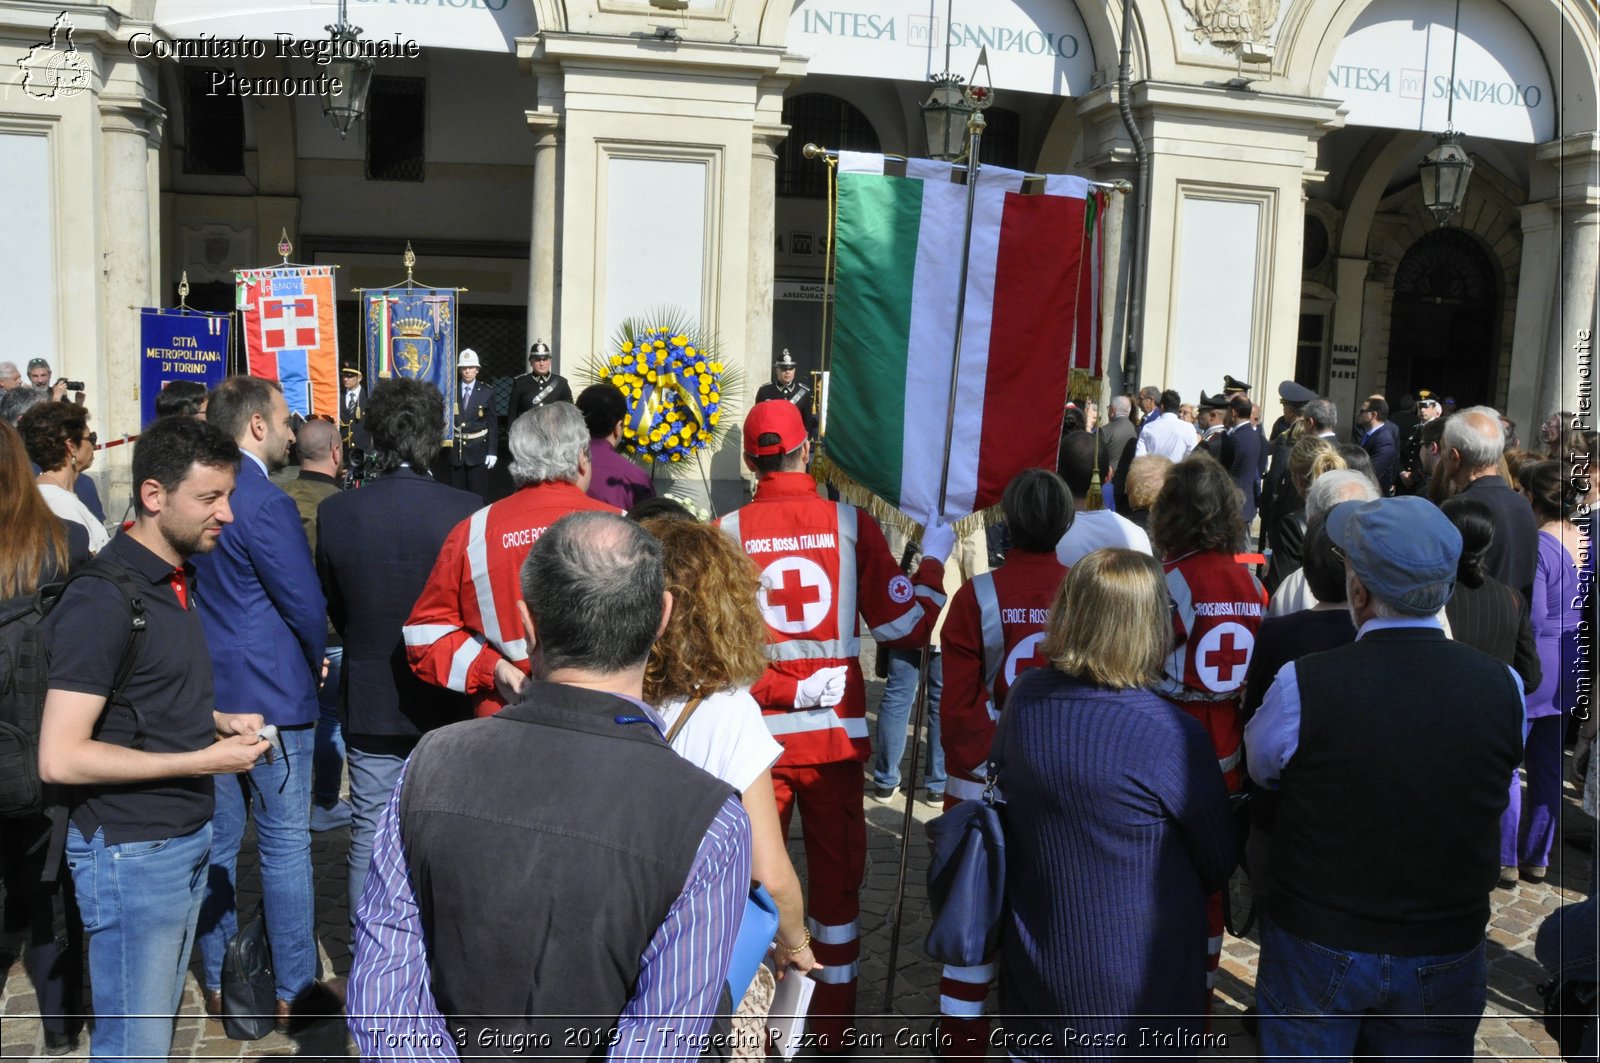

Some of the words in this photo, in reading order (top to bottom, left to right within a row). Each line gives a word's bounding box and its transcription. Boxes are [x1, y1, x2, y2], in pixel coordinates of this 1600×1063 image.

[803, 9, 896, 41] INTESA
[949, 22, 1079, 59] SANPAOLO
[1326, 65, 1391, 93] NTESA
[1432, 75, 1543, 109] SANPAOLO
[265, 282, 308, 293] PEMONTE
[172, 336, 198, 348] CITTÀ
[146, 347, 222, 361] METROPOLITANA
[162, 361, 171, 372] DI
[174, 362, 207, 374] TORINO
[502, 529, 531, 548] CROCE
[745, 539, 772, 554] CROCE
[772, 537, 800, 552] ROSSA
[799, 533, 836, 550] ITALIANA
[1002, 608, 1026, 624] CROCE
[1234, 602, 1263, 616] ITALIAN
